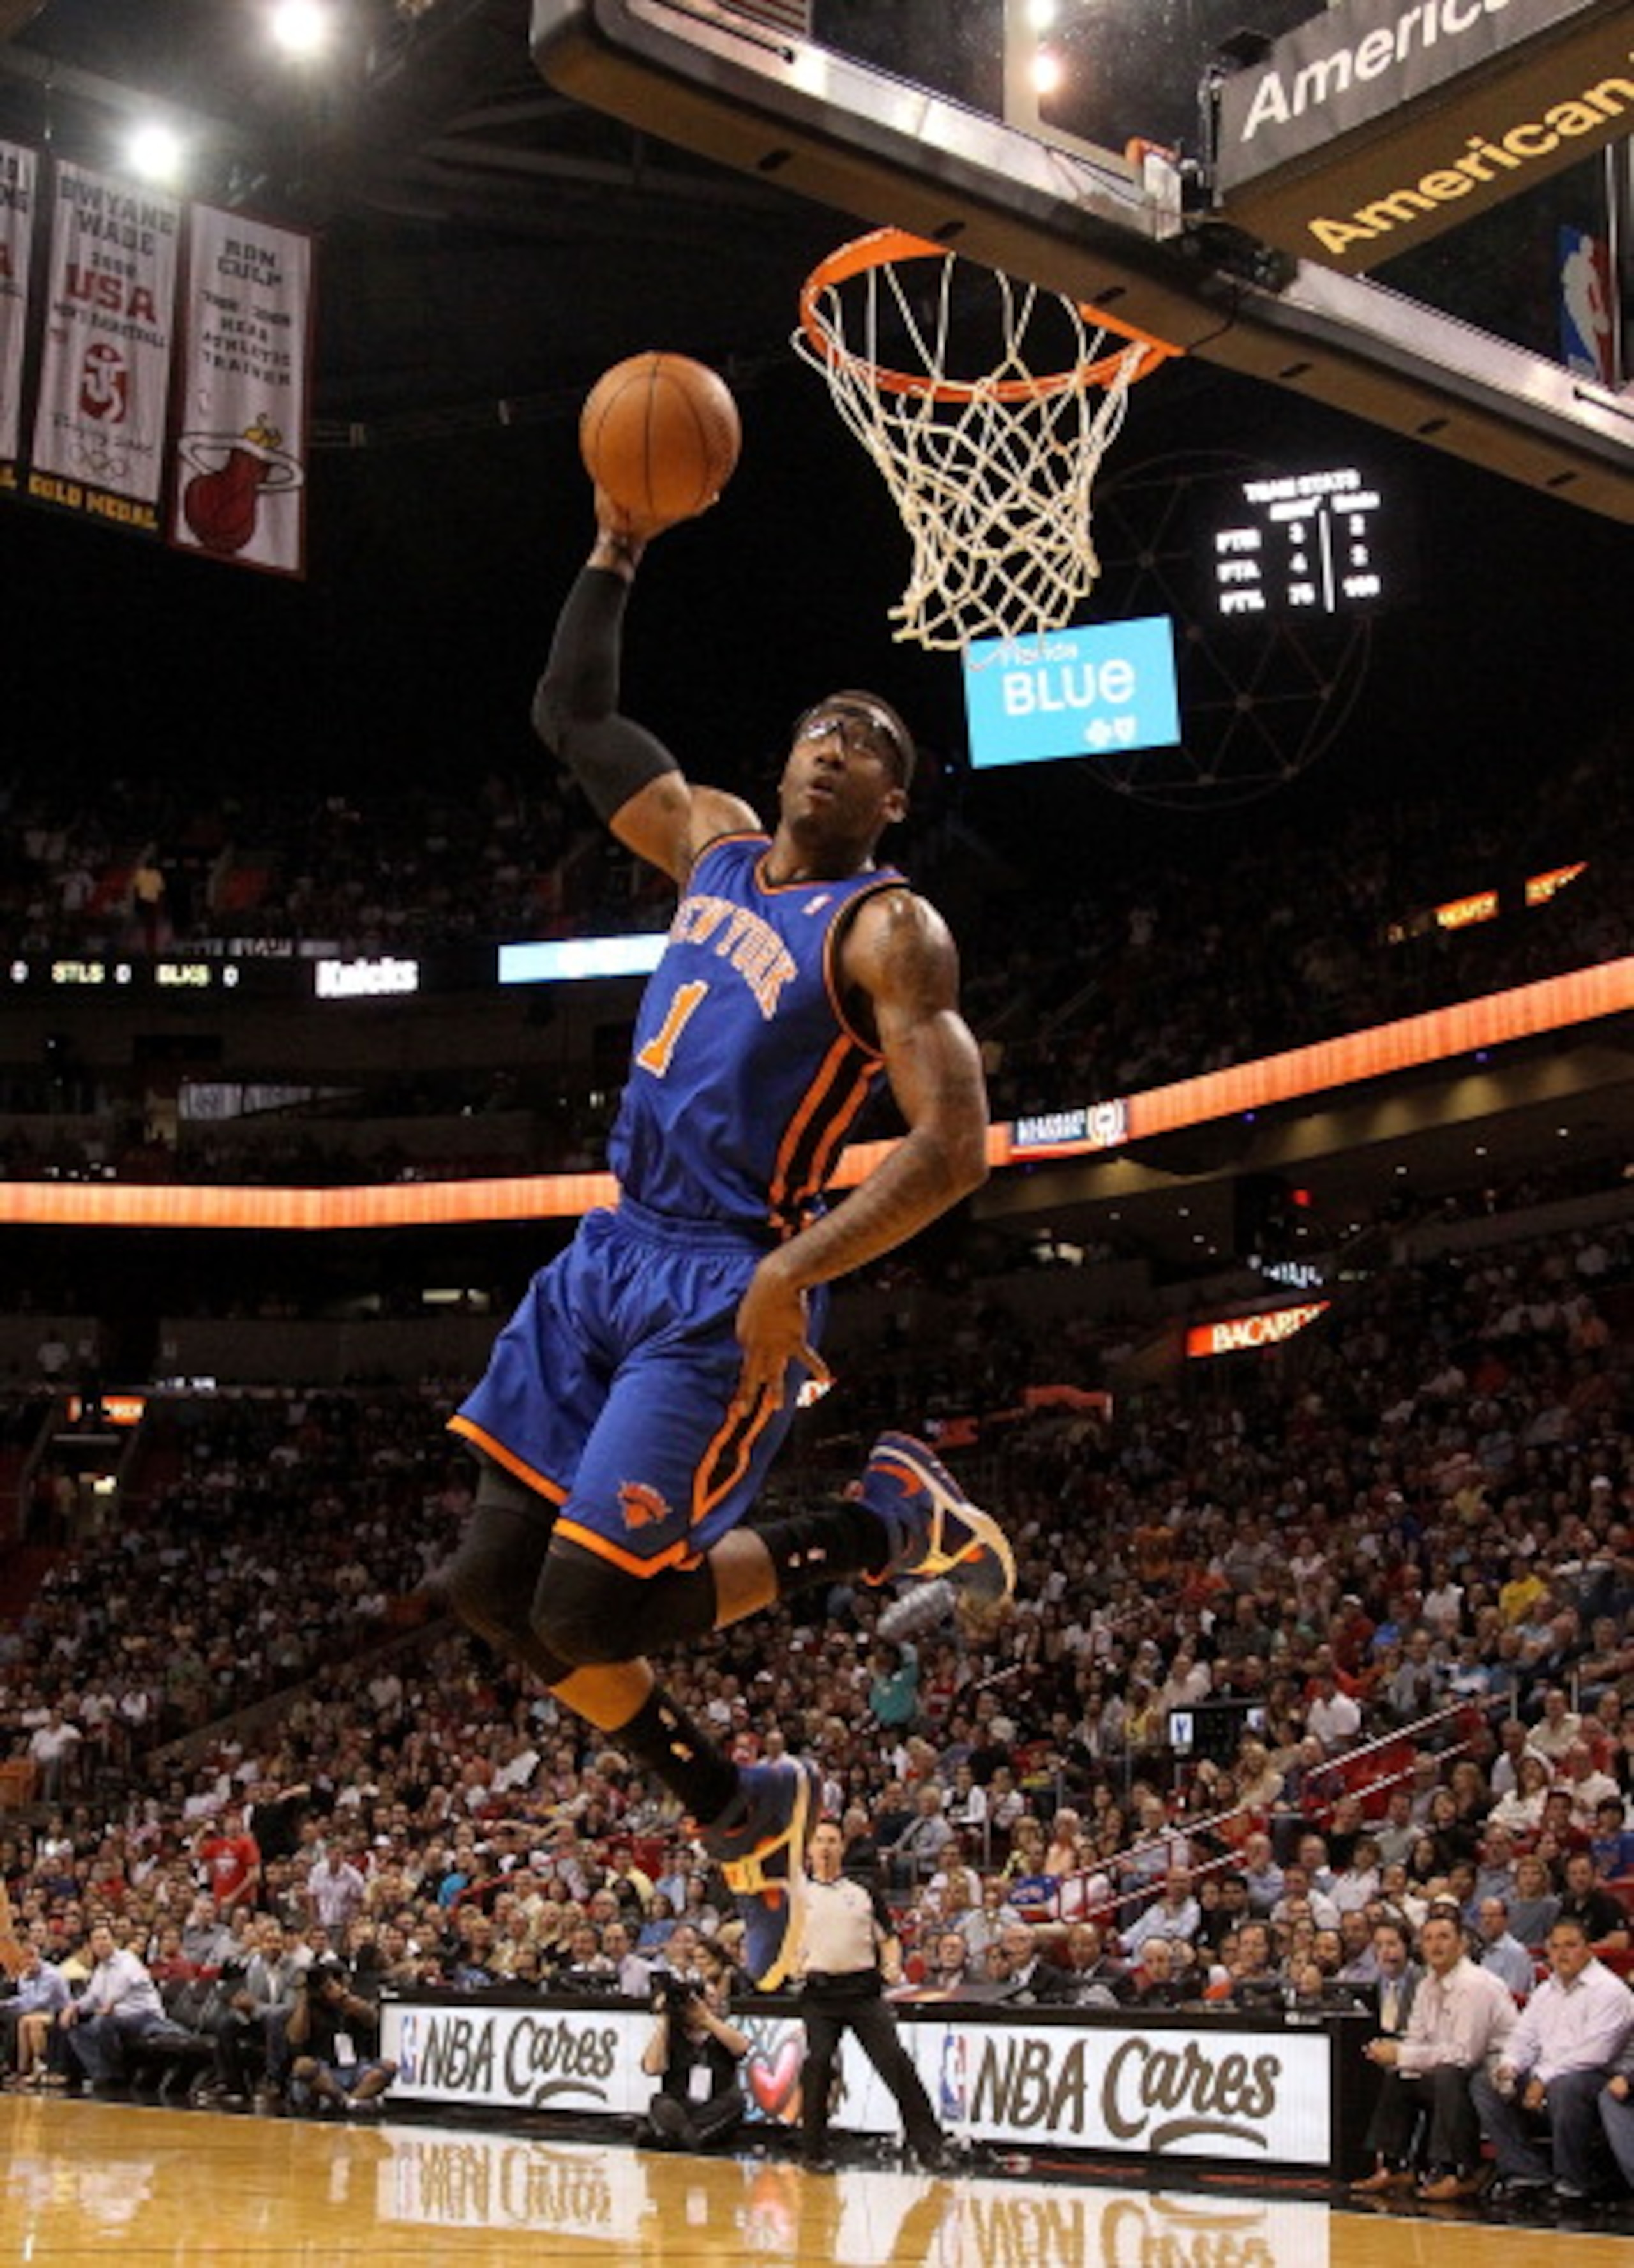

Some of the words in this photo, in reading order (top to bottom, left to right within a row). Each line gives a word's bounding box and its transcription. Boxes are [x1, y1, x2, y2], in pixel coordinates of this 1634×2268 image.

[66, 263, 157, 323] USA
[29, 474, 82, 507] GOLD
[636, 980, 710, 1078] 1
[419, 2016, 496, 2094] NBA
[503, 2016, 620, 2108] Cares
[971, 2036, 1088, 2133] NBA
[1101, 2036, 1280, 2150] Cares
